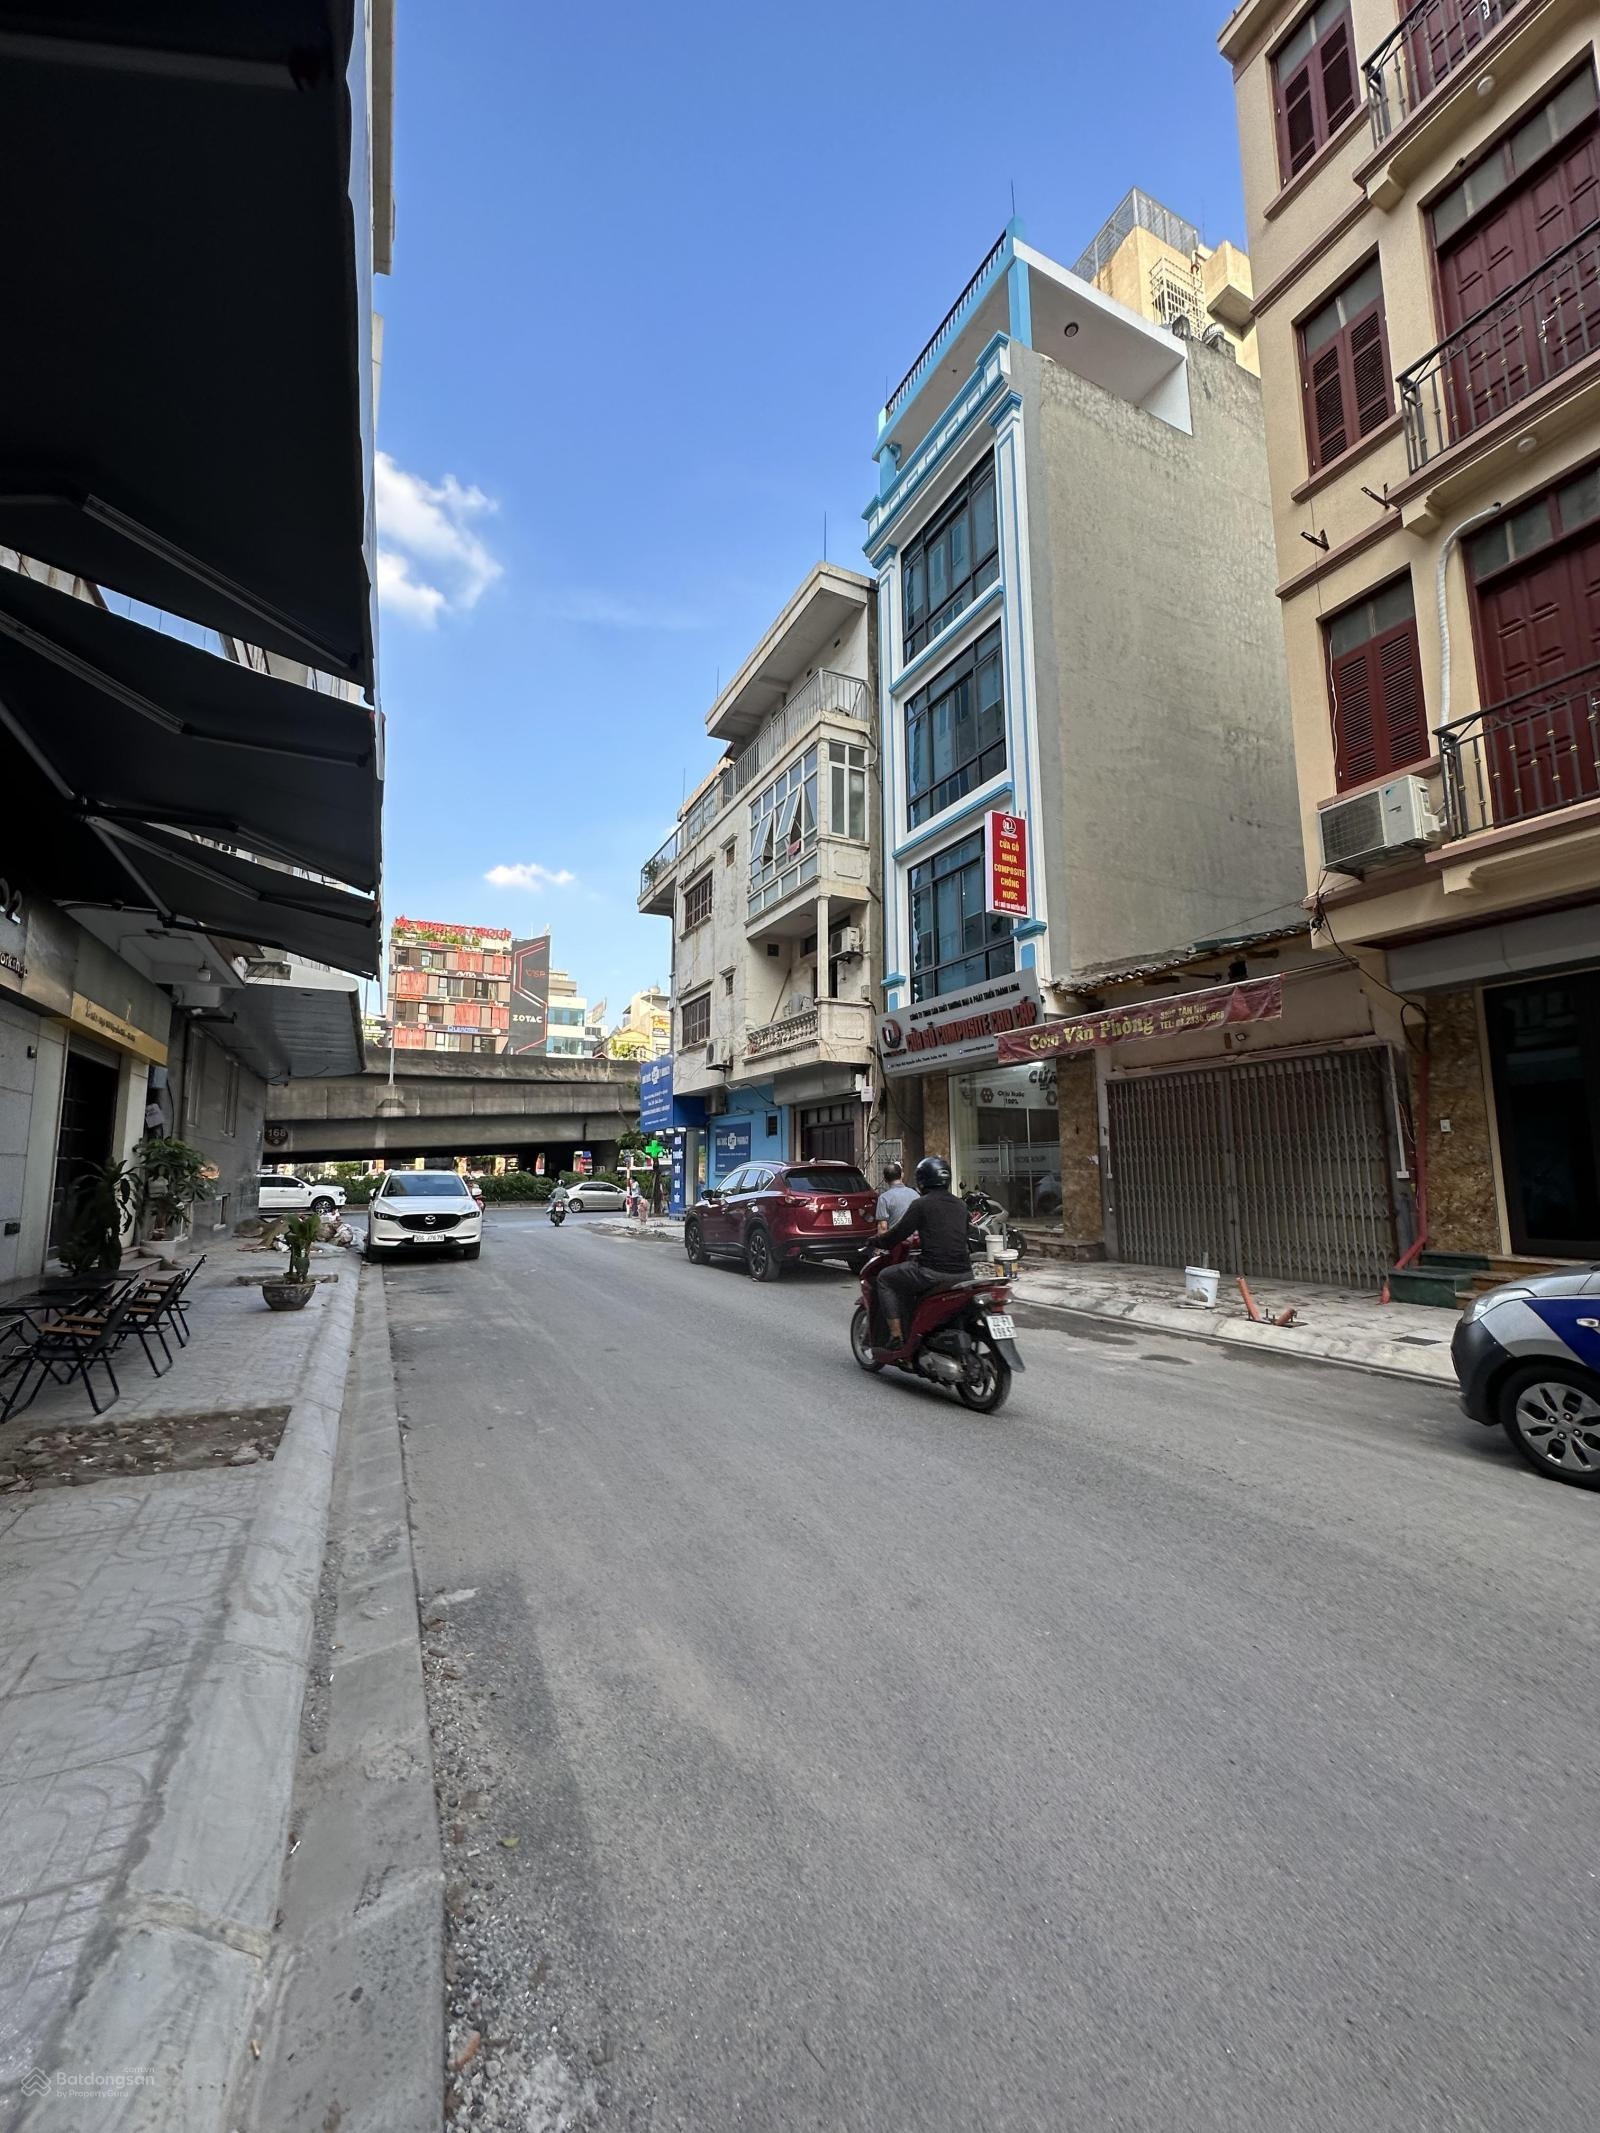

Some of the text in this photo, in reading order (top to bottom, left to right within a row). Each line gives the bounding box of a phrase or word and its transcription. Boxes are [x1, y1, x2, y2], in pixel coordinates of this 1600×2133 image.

[1001, 852, 1018, 863] NHỰA
[994, 863, 1025, 878] COMPOSITE
[1000, 876, 1020, 889] CHỐNG
[1002, 889, 1018, 900] NƯỚC
[512, 1014, 543, 1024] ZOTAC
[938, 1014, 991, 1045] COMPOSITE
[990, 1008, 1014, 1034] CAO
[1013, 996, 1037, 1027] CẤP
[1160, 1020, 1175, 1030] TEL:
[1030, 1016, 1154, 1050] Cơm Văn Phòng
[268, 1128, 286, 1137] 168
